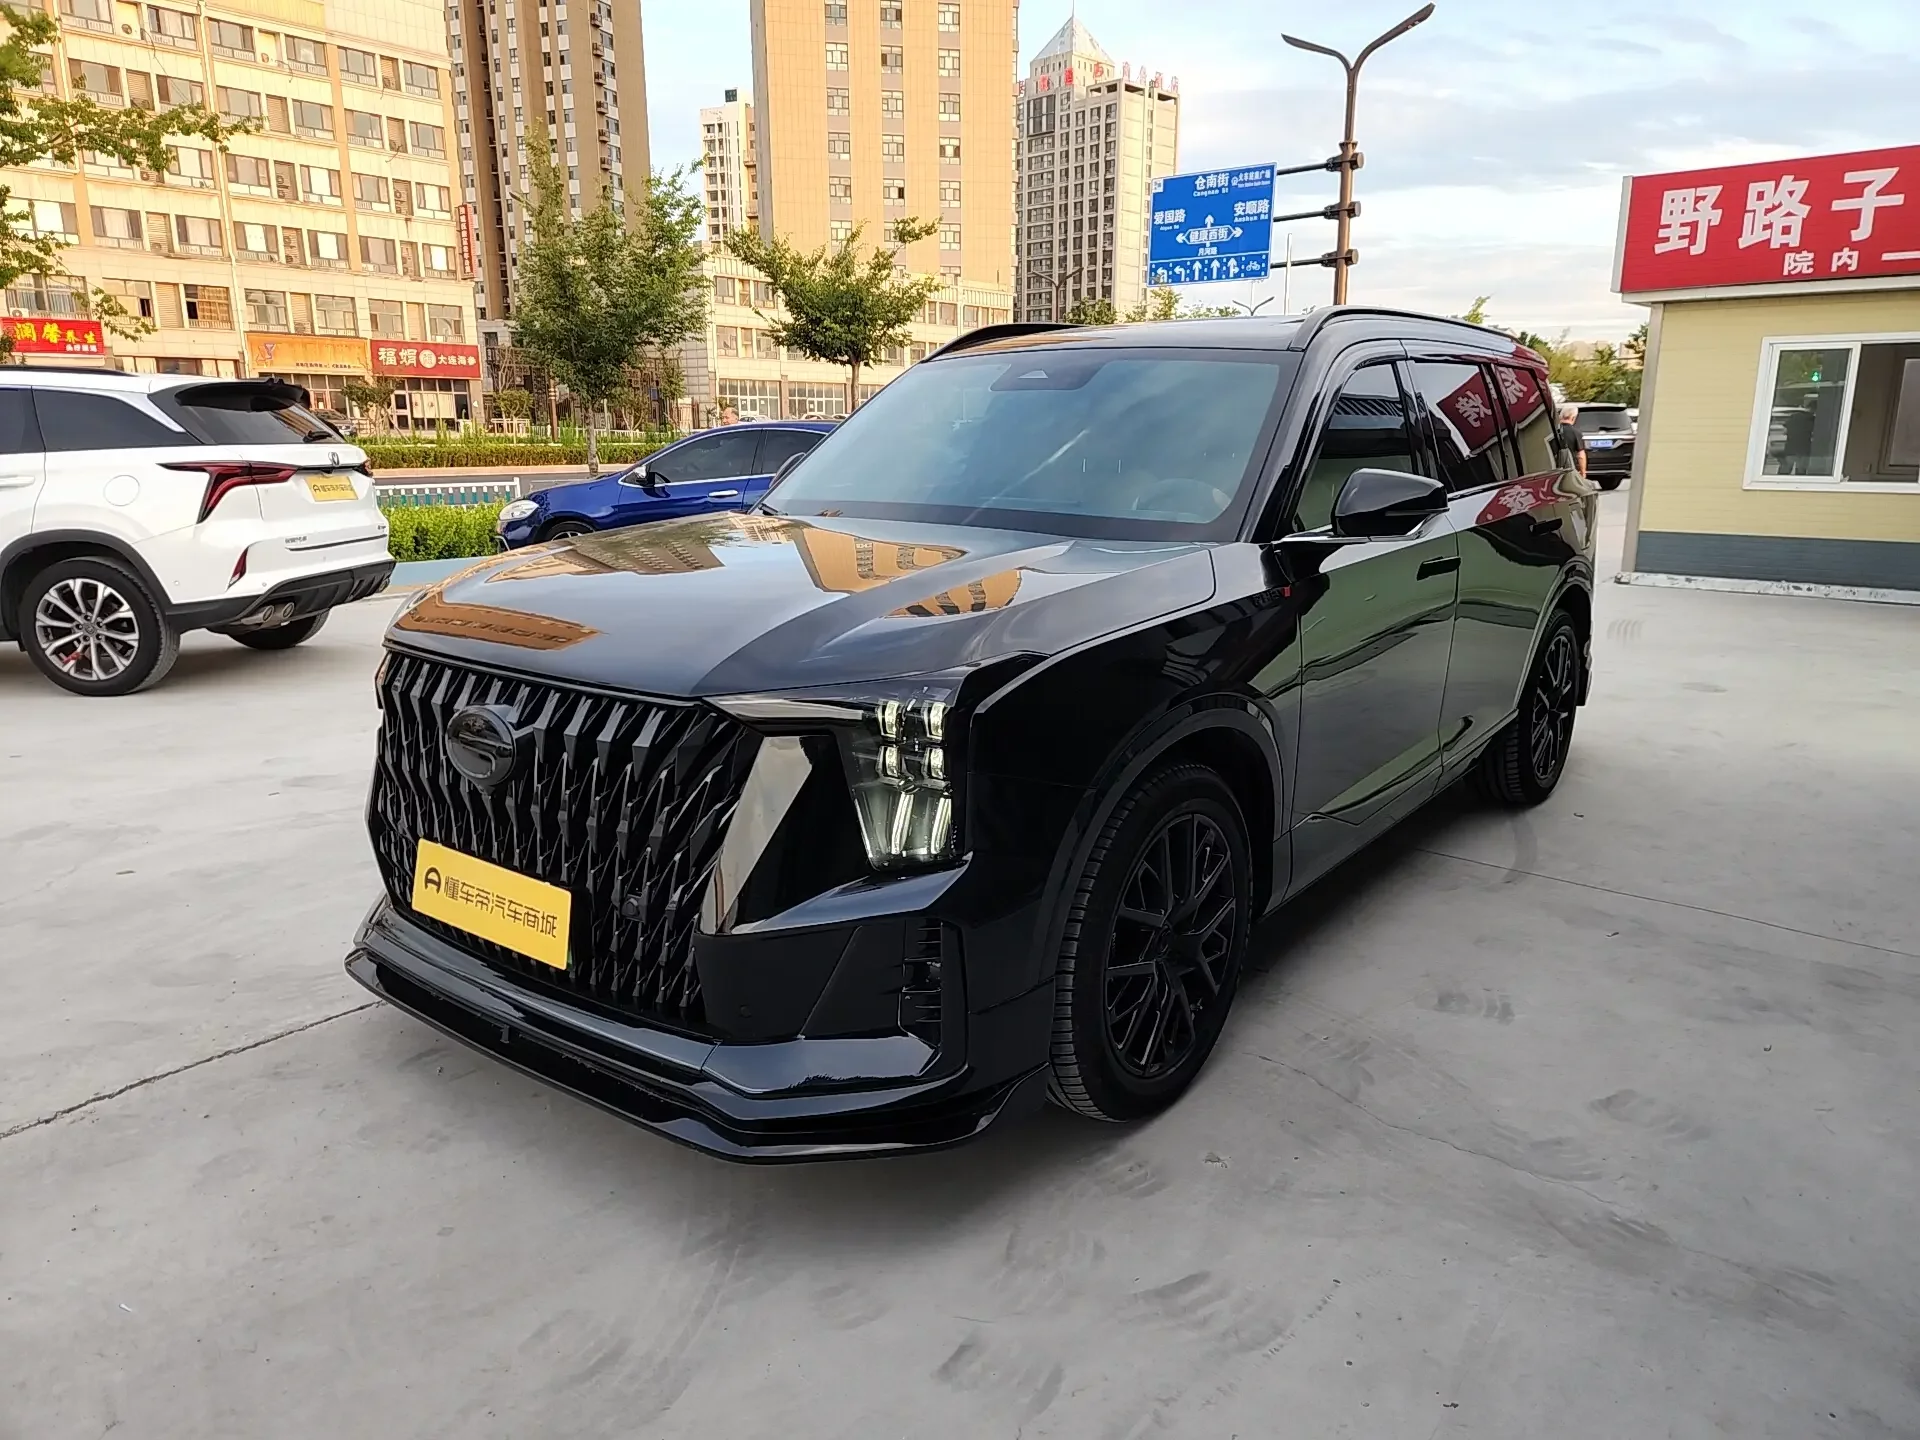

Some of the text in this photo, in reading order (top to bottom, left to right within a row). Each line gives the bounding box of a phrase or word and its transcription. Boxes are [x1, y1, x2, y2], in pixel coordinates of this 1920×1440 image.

[1195, 173, 1229, 191] 仓南街
[1233, 198, 1270, 216] 安顺路
[1654, 167, 1905, 256] 野路子
[1154, 208, 1186, 225] 爱国路
[1189, 227, 1228, 243] 健康西街
[438, 355, 477, 366] 大连海参
[443, 875, 558, 939] 懂车帝汽车商城
